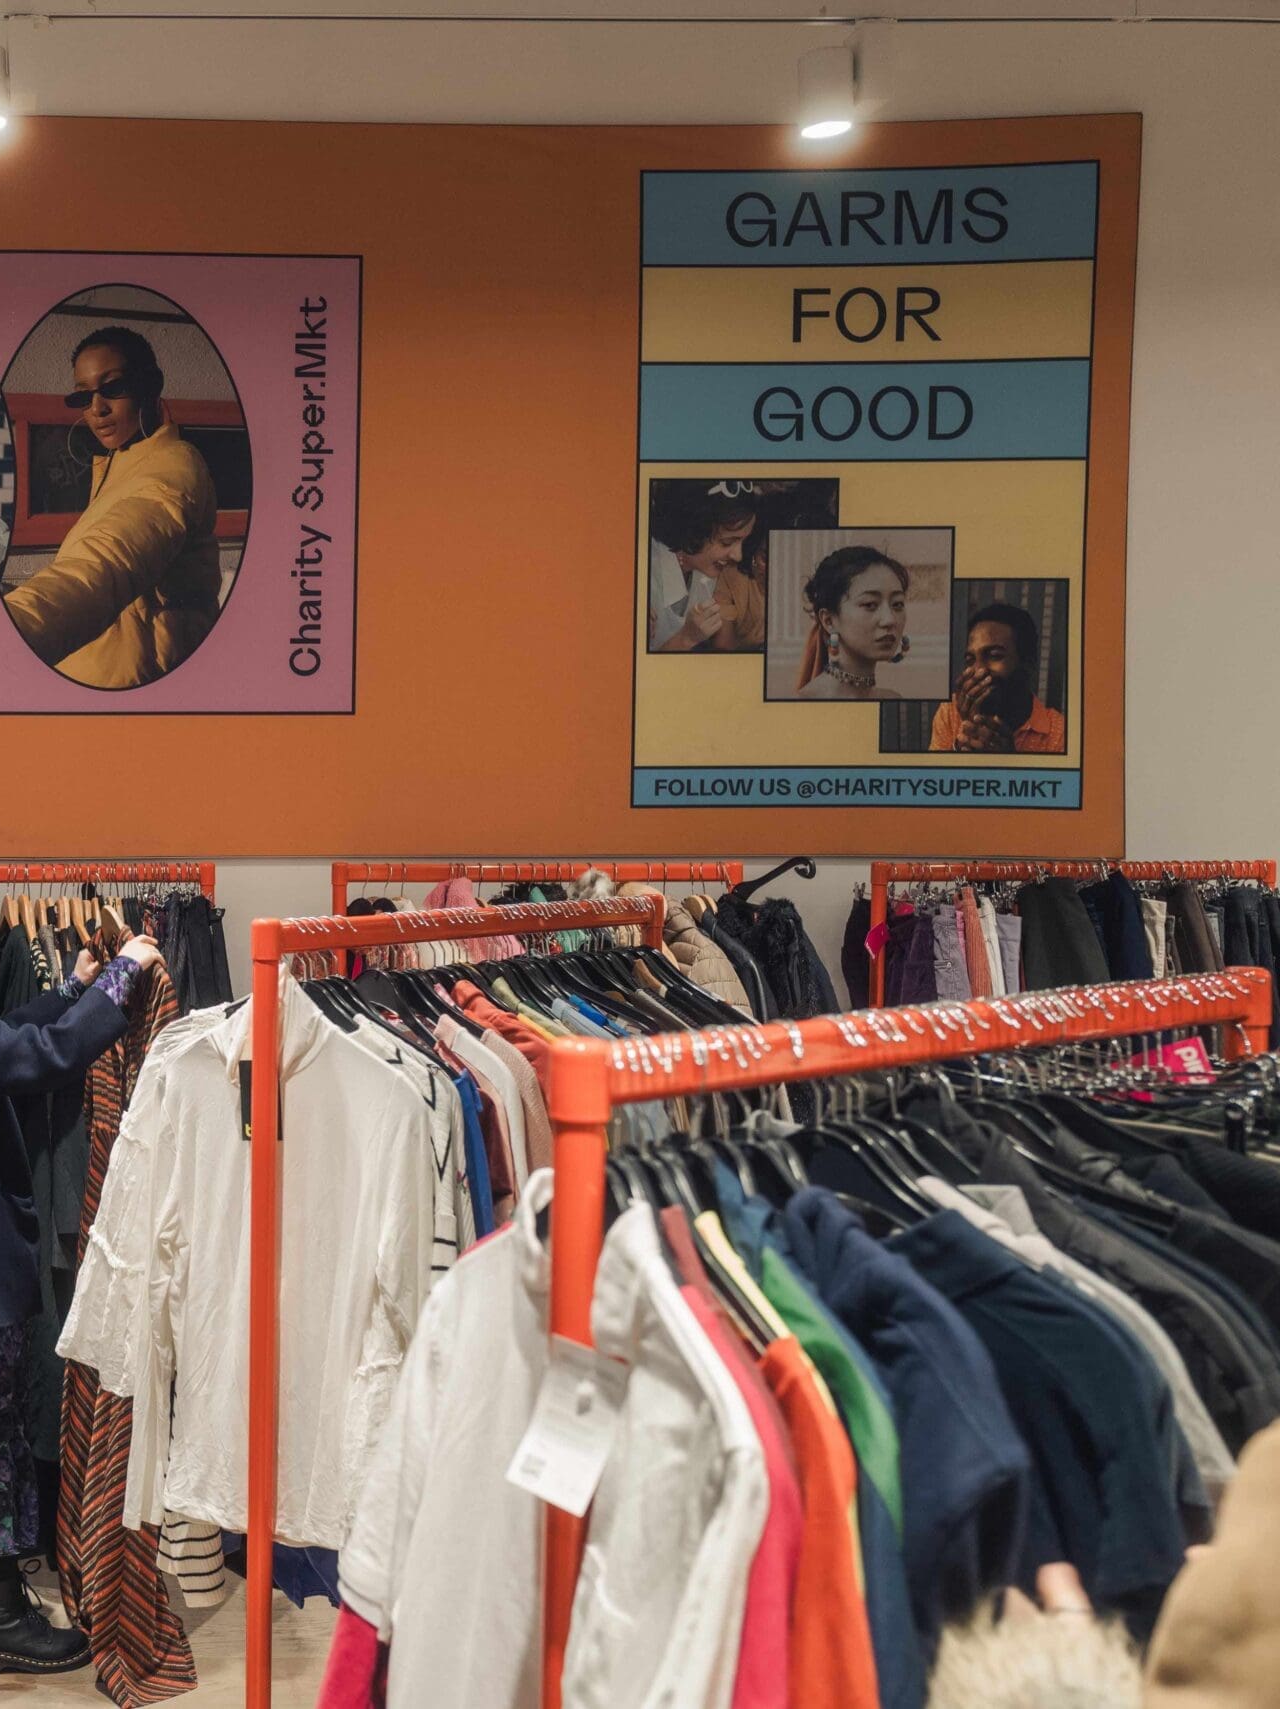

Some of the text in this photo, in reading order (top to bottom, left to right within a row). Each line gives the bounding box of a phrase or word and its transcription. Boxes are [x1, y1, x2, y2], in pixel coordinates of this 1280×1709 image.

[724, 185, 1010, 248] GARMS
[791, 285, 943, 343] FOR
[752, 384, 975, 443] GOOD
[288, 295, 334, 677] Charity Super.Mkt
[653, 777, 1063, 799] FOLLOW US @CHARITYSUPER.MKT
